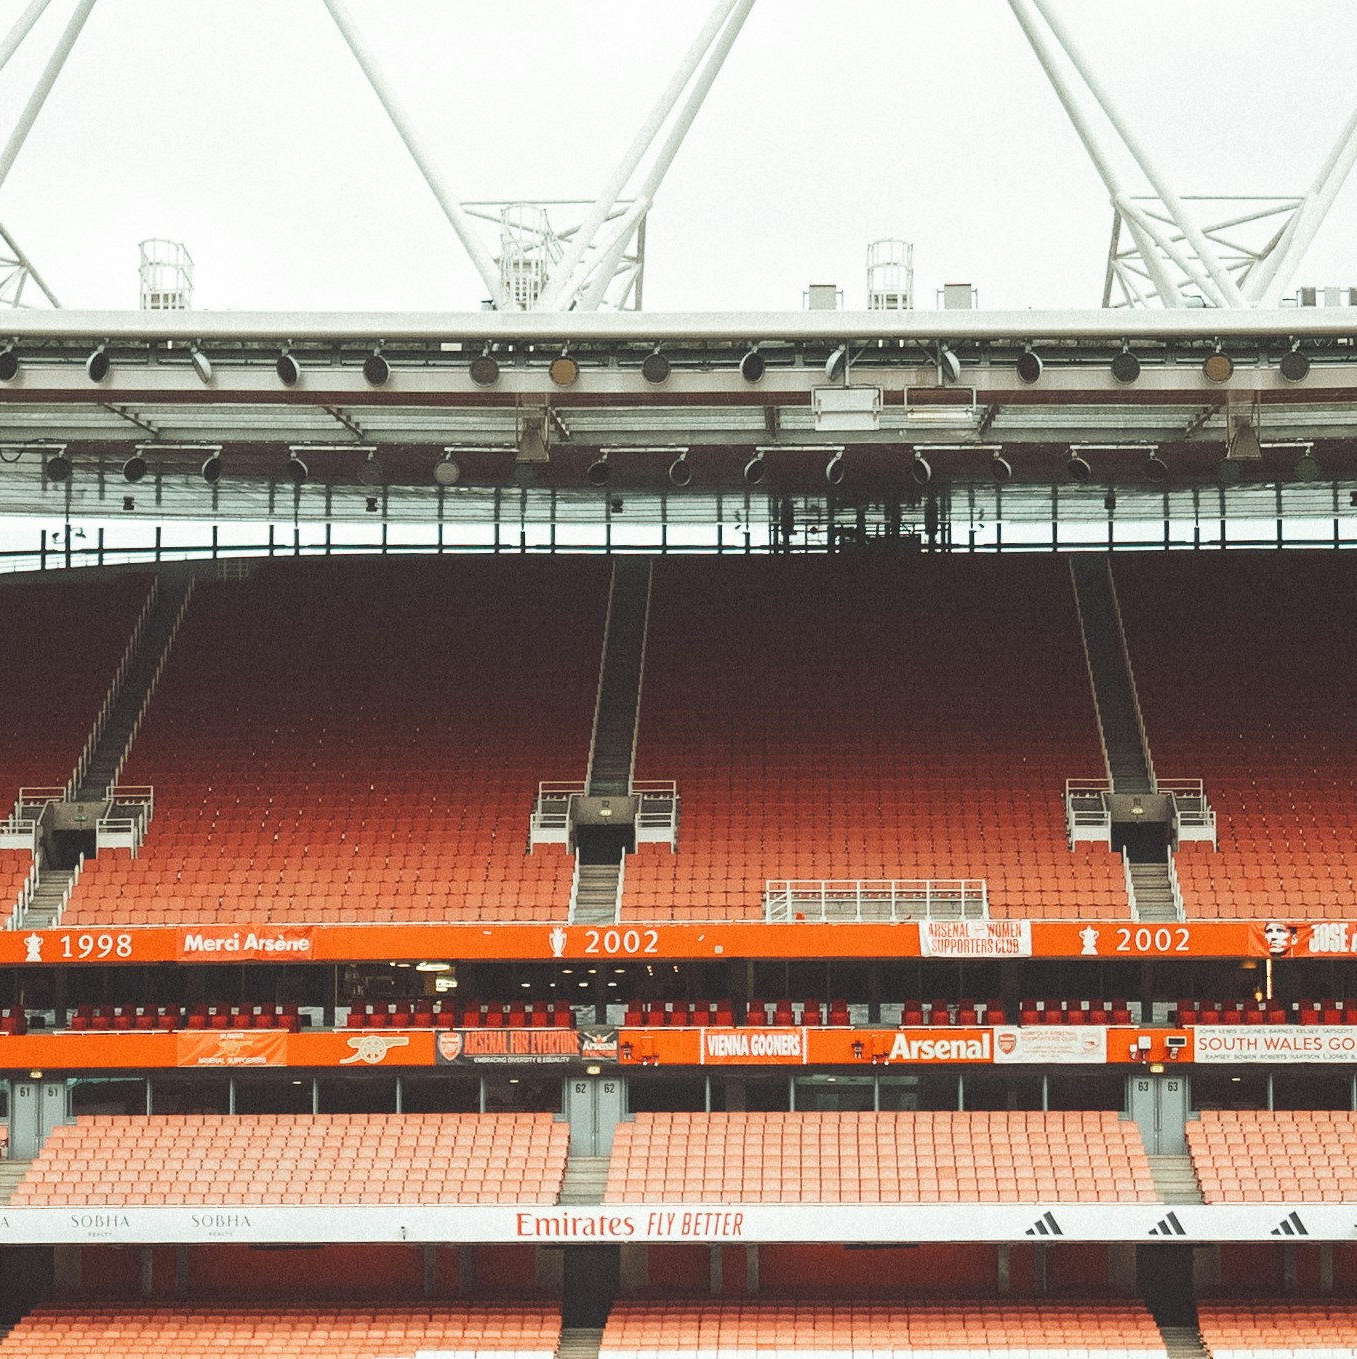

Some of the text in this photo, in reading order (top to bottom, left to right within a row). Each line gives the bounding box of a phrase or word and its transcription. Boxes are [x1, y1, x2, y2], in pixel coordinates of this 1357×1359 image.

[928, 922, 1022, 938] ARSENAL WOMEN
[1309, 923, 1348, 952] JOSE
[59, 934, 133, 958] 1998
[185, 933, 310, 952] Merci Arsène
[584, 930, 659, 953] 2002
[931, 938, 1020, 953] SUPPORTERS CLUB
[1116, 928, 1190, 952] 2002
[464, 1031, 508, 1054] ARSENAL
[510, 1031, 530, 1054] FOR
[707, 1034, 801, 1057] VIENNA GOONERS
[889, 1033, 990, 1059] Arsenal
[1198, 1037, 1258, 1051] SOUTH
[1264, 1037, 1323, 1051] WALES
[575, 1084, 586, 1095] 62
[604, 1084, 615, 1095] 62
[1138, 1081, 1149, 1092] 63
[1167, 1081, 1178, 1092] 63
[71, 1214, 130, 1228] SOBHA
[191, 1214, 251, 1228] SOBHA
[516, 1212, 744, 1236] Emirates FLY BETTER
